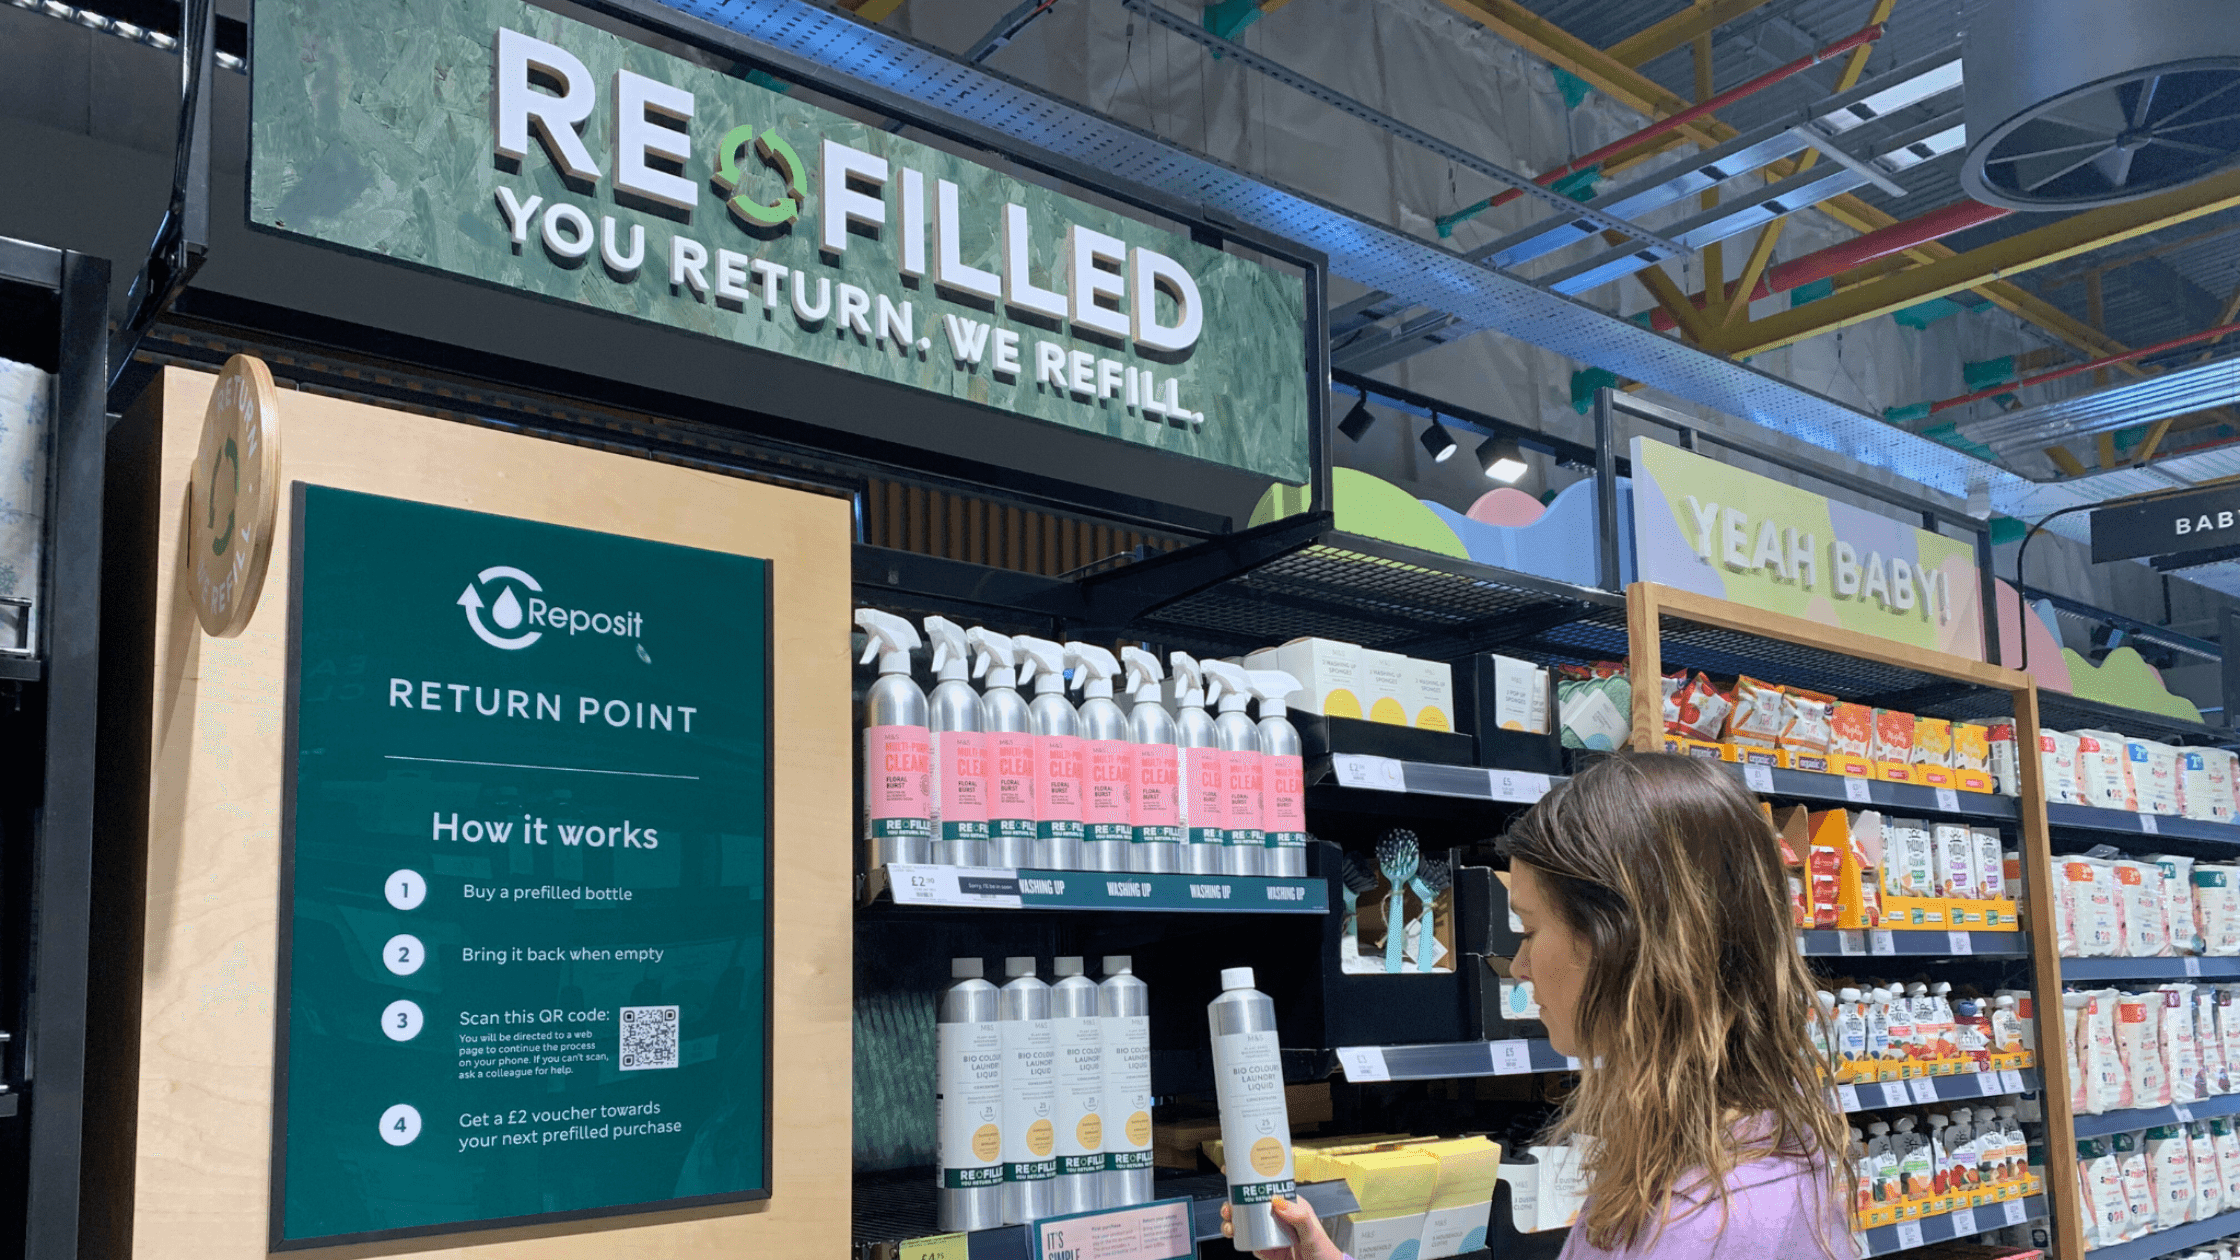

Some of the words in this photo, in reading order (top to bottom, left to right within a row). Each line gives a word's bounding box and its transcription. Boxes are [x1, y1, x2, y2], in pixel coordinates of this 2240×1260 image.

[494, 185, 646, 273] YOU
[669, 234, 932, 350] RETURN.
[942, 313, 1021, 374] WE
[1034, 339, 1204, 424] REFILL.
[216, 374, 258, 460] RETURN
[2175, 509, 2240, 535] BAB
[1686, 494, 1817, 588] YEAH
[1831, 539, 1952, 623] BABY!
[528, 597, 643, 638] Reposit
[389, 677, 561, 722] RETURN
[579, 696, 698, 733] POINT
[432, 811, 514, 844] How
[524, 813, 548, 845] it
[557, 820, 658, 850] works
[401, 882, 410, 899] 1
[464, 883, 497, 902] Buy
[500, 887, 509, 899] a
[513, 885, 581, 902] prefilled
[585, 886, 633, 901] bottle
[1019, 878, 1054, 895] WASHING
[1054, 879, 1066, 895] UP
[1106, 881, 1141, 897] WASHING
[1141, 883, 1152, 898] UP
[1189, 883, 1221, 899] WASHING
[1221, 884, 1232, 899] UP
[1266, 886, 1296, 901] WASHING
[1296, 886, 1306, 901] UP
[397, 946, 411, 963] 2
[462, 946, 507, 965] Bring
[512, 946, 523, 961] it
[527, 946, 566, 961] back
[569, 946, 611, 961] when
[614, 946, 665, 963] empty
[396, 1012, 409, 1030] 3
[459, 1010, 500, 1026] Scan
[504, 1009, 535, 1024] this
[539, 1009, 564, 1023] QR
[568, 1007, 611, 1022] code:
[459, 1034, 478, 1043] You
[480, 1032, 497, 1042] will
[499, 1032, 511, 1042] be
[513, 1031, 552, 1041] directed
[554, 1031, 565, 1040] to
[574, 1030, 593, 1039] web
[459, 1047, 484, 1057] page
[486, 1045, 497, 1054] to
[498, 1043, 541, 1054] continue
[542, 1042, 559, 1052] the
[560, 1042, 596, 1052] process
[963, 1054, 978, 1063] BIO
[1018, 1051, 1032, 1060] BIO
[458, 1059, 472, 1067] on
[473, 1059, 496, 1069] your
[498, 1056, 531, 1067] phone.
[533, 1054, 541, 1064] If
[542, 1056, 560, 1065] you
[561, 1053, 583, 1063] can't
[585, 1053, 609, 1063] scan,
[458, 1070, 476, 1079] ask
[485, 1067, 533, 1079] colleague
[534, 1066, 548, 1075] for
[550, 1065, 574, 1076] help.
[1233, 1066, 1248, 1076] BIO
[1247, 1082, 1274, 1092] LIQUID
[459, 1112, 490, 1128] Get
[493, 1114, 503, 1126] a
[507, 1109, 528, 1125] £2
[531, 1106, 597, 1123] voucher
[600, 1101, 661, 1118] towards
[392, 1116, 408, 1134] 4
[458, 1135, 498, 1153] your
[502, 1129, 538, 1146] next
[542, 1122, 609, 1146] prefilled
[613, 1120, 682, 1140] purchase
[1047, 1230, 1064, 1251] IT'S
